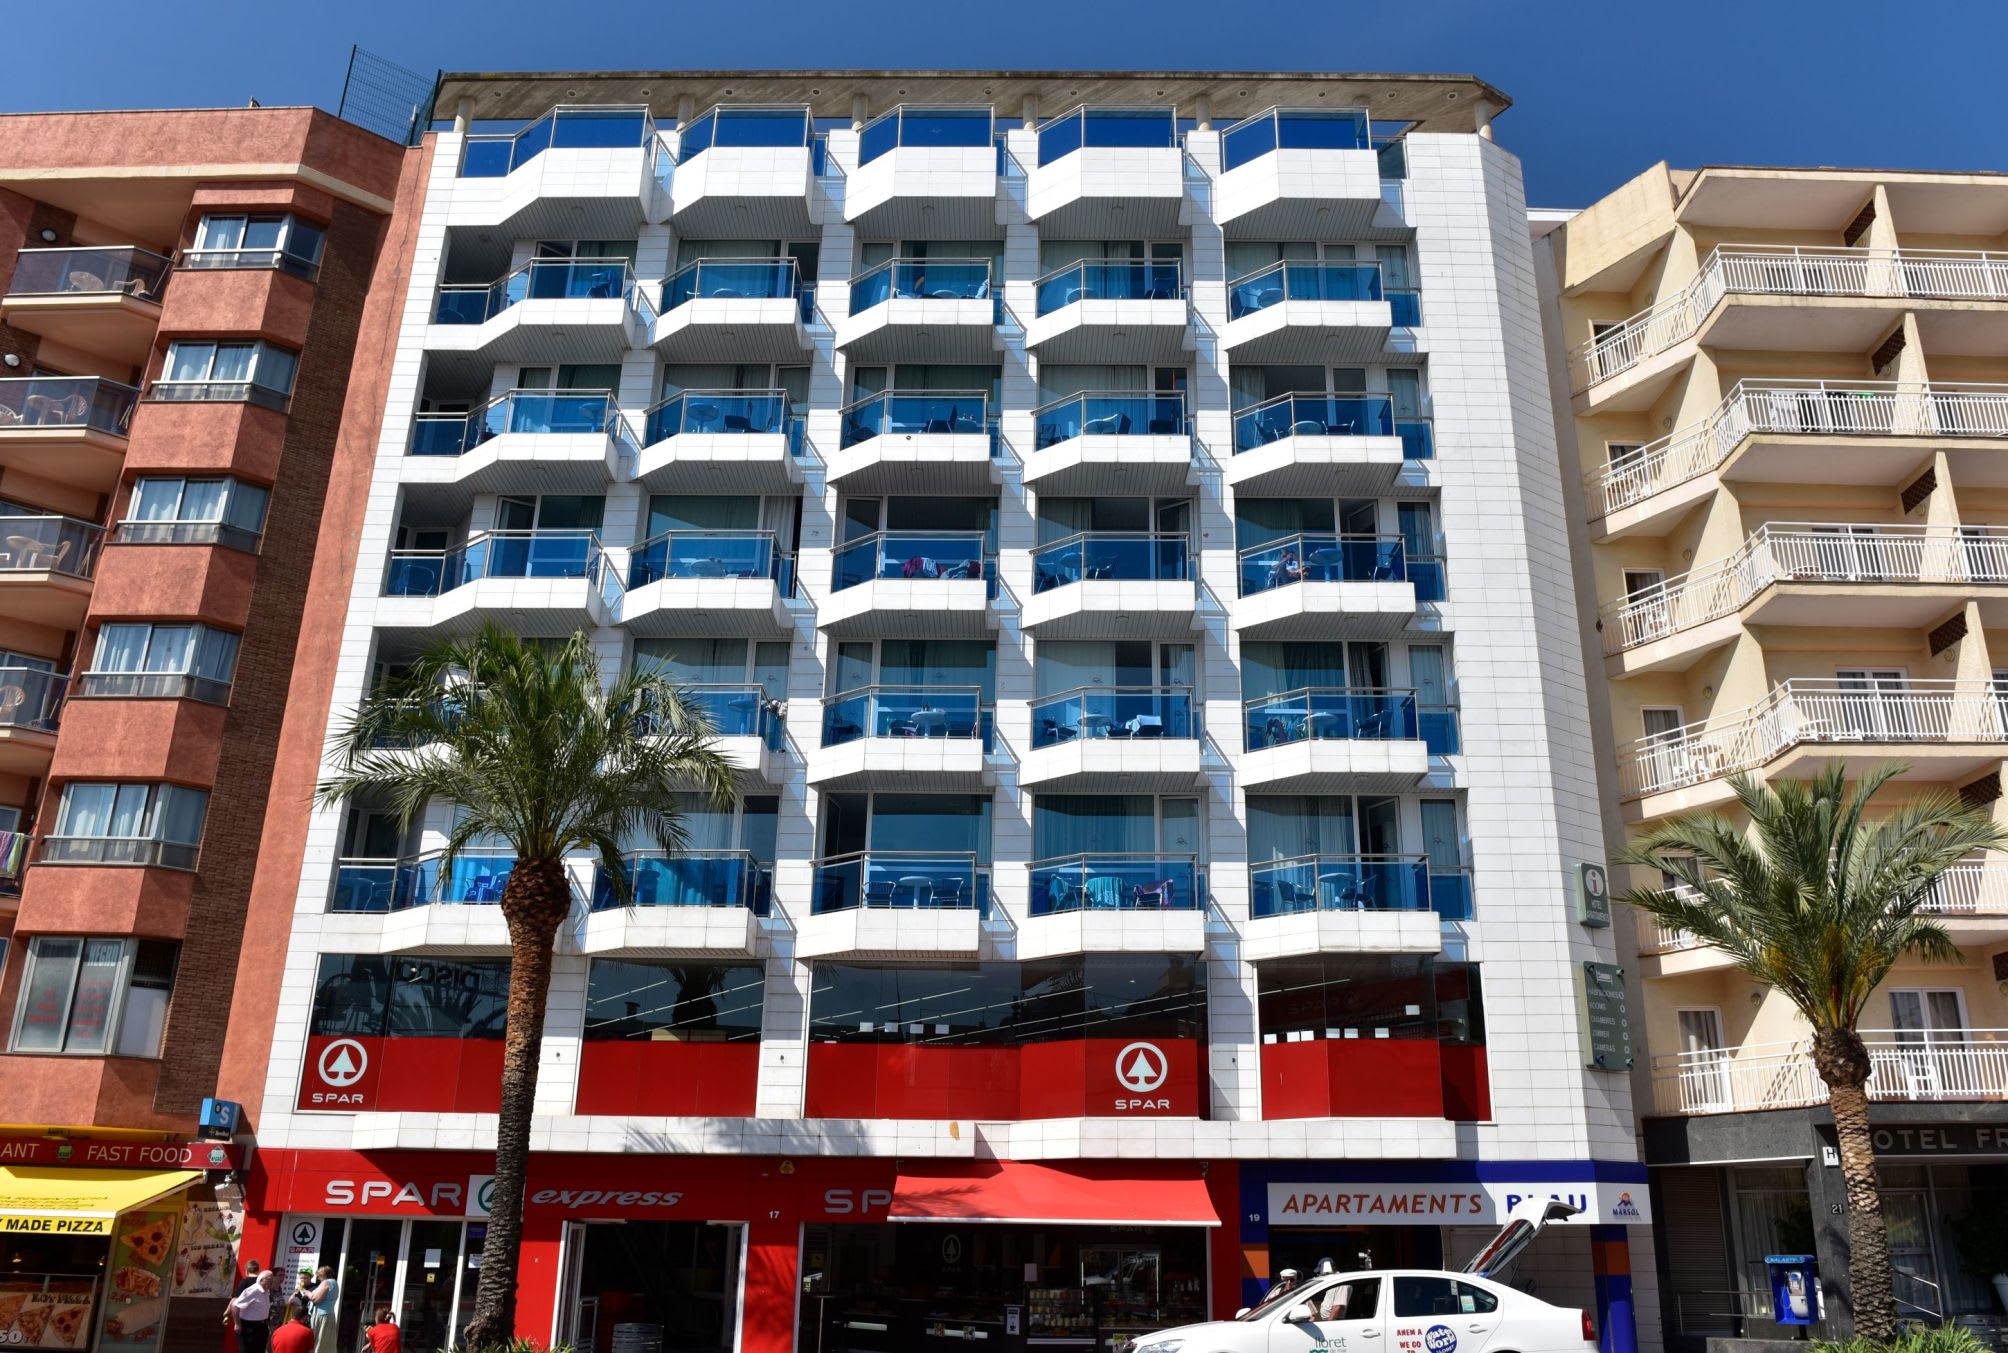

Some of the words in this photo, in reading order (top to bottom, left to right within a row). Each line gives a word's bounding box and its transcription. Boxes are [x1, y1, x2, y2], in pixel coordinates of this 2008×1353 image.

[312, 1092, 364, 1104] SPAR
[1114, 1099, 1170, 1110] SPAR
[1872, 1128, 1957, 1150] OTEL
[87, 1145, 134, 1161] FAST
[139, 1147, 192, 1163] FOOD
[1826, 1148, 1836, 1159] H
[325, 1180, 462, 1207] SPAR
[531, 1188, 683, 1209] express
[1282, 1193, 1482, 1215] APARTAMENTS
[1506, 1194, 1587, 1215] BU
[1831, 1203, 1843, 1214] 21
[768, 1210, 780, 1219] 17
[1248, 1213, 1261, 1222] 19
[1612, 1208, 1640, 1216] MARSOL
[5, 1218, 52, 1231] MADE
[56, 1220, 103, 1232] PIZZA
[1396, 1328, 1416, 1337] ANEM
[1417, 1328, 1423, 1336] A
[1315, 1336, 1348, 1348] lloret
[1399, 1341, 1410, 1349] WE
[1412, 1340, 1422, 1348] GO
